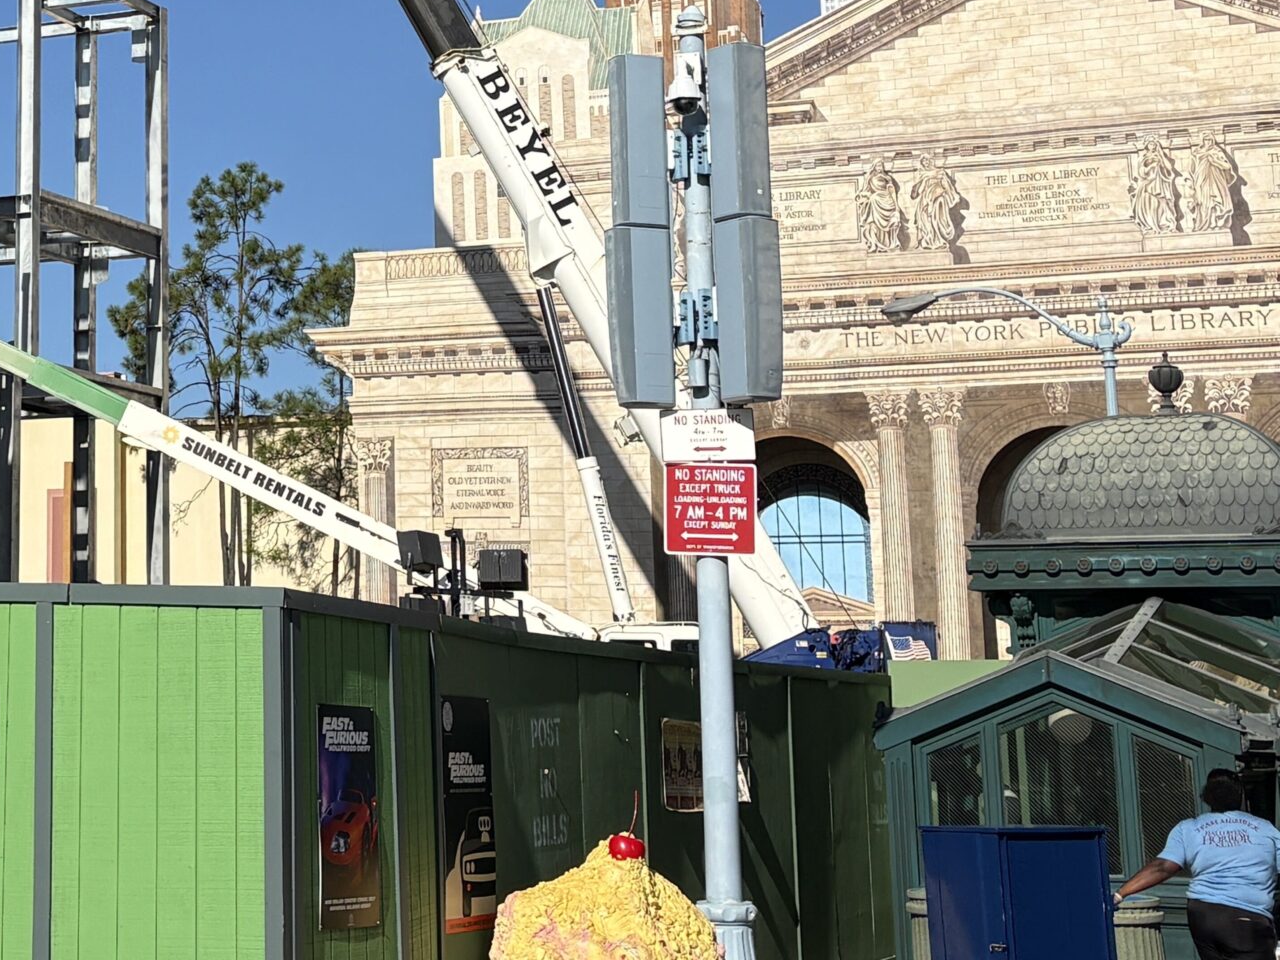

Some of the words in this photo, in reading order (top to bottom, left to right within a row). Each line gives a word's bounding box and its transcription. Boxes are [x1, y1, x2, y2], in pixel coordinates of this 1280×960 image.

[476, 65, 579, 227] BEYEL
[985, 174, 1008, 186] THE
[1012, 171, 1049, 183] LENOX
[1053, 167, 1100, 181] LIBRARY
[1019, 183, 1054, 192] FOUNDED
[1056, 182, 1067, 190] BY
[779, 189, 822, 202] LIBRARY
[1006, 192, 1041, 203] JAMES
[1045, 189, 1081, 199] LENOX
[995, 201, 1039, 210] DEDICATED
[1041, 199, 1051, 207] TO
[1055, 196, 1094, 206] HISTORY
[785, 210, 814, 219] ASTOR
[978, 209, 1028, 219] LITERATURE
[1048, 206, 1065, 214] THE
[1068, 204, 1089, 212] FINE
[1090, 202, 1110, 211] ARTS
[840, 332, 884, 348] THE
[894, 327, 947, 346] NEW
[960, 323, 1024, 342] YORK
[1151, 309, 1274, 332] LIBRARY
[674, 415, 688, 426] NO
[693, 414, 741, 425] STANDING
[466, 464, 493, 472] BEAUTY
[675, 468, 690, 481] NO
[694, 469, 746, 482] STANDING
[182, 436, 253, 480] SUNBELT
[253, 471, 327, 517] RENTALS
[448, 477, 464, 485] OLD
[464, 477, 478, 485] YET
[479, 477, 496, 485] EVER
[456, 489, 485, 497] ETERNAL
[486, 489, 506, 497] VOICE
[679, 483, 710, 493] EXCEPT
[713, 484, 741, 494] TRUCK
[450, 502, 464, 510] AND
[465, 502, 491, 510] INWARD
[492, 501, 514, 509] WORD
[674, 505, 682, 518] 7
[729, 506, 747, 520] PM
[684, 520, 709, 529] EXCEPT
[711, 521, 736, 530] SUNDAY
[593, 495, 614, 550] Florida's
[607, 554, 625, 592] Finest
[322, 716, 350, 734] FAST
[325, 730, 368, 748] FURIOUS
[530, 718, 561, 748] POST
[450, 764, 484, 781] FURIOUS
[540, 768, 557, 798] NO
[533, 814, 568, 847] BILLS
